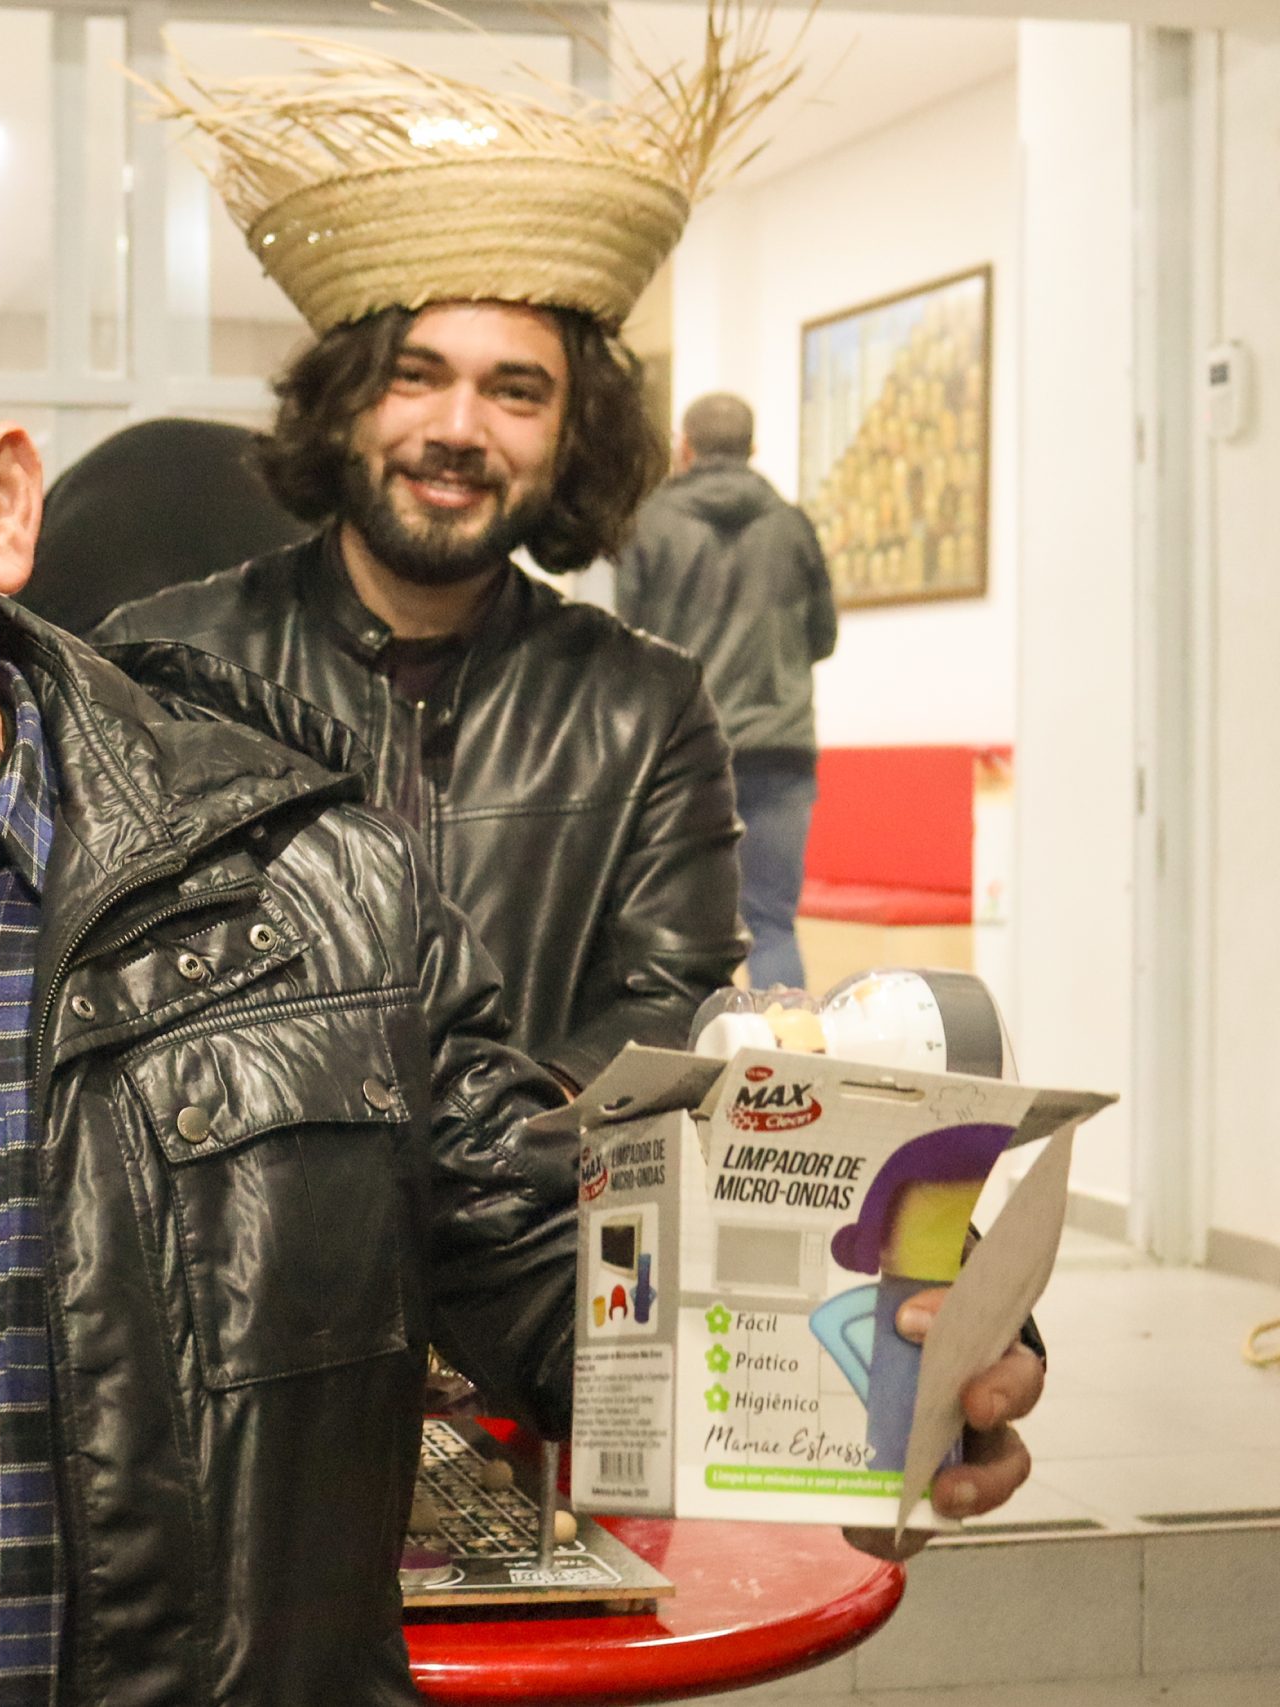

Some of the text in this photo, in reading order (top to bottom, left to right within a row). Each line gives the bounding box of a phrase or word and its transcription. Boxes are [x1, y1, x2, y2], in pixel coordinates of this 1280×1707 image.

[734, 1083, 813, 1109] MAX
[652, 1139, 666, 1160] DE
[722, 1144, 866, 1180] LIMPADOR DE
[713, 1173, 855, 1210] MICRO-ONDAS
[736, 1313, 778, 1332] Fácil
[735, 1352, 799, 1372] Prático
[734, 1391, 820, 1414] Higiênico
